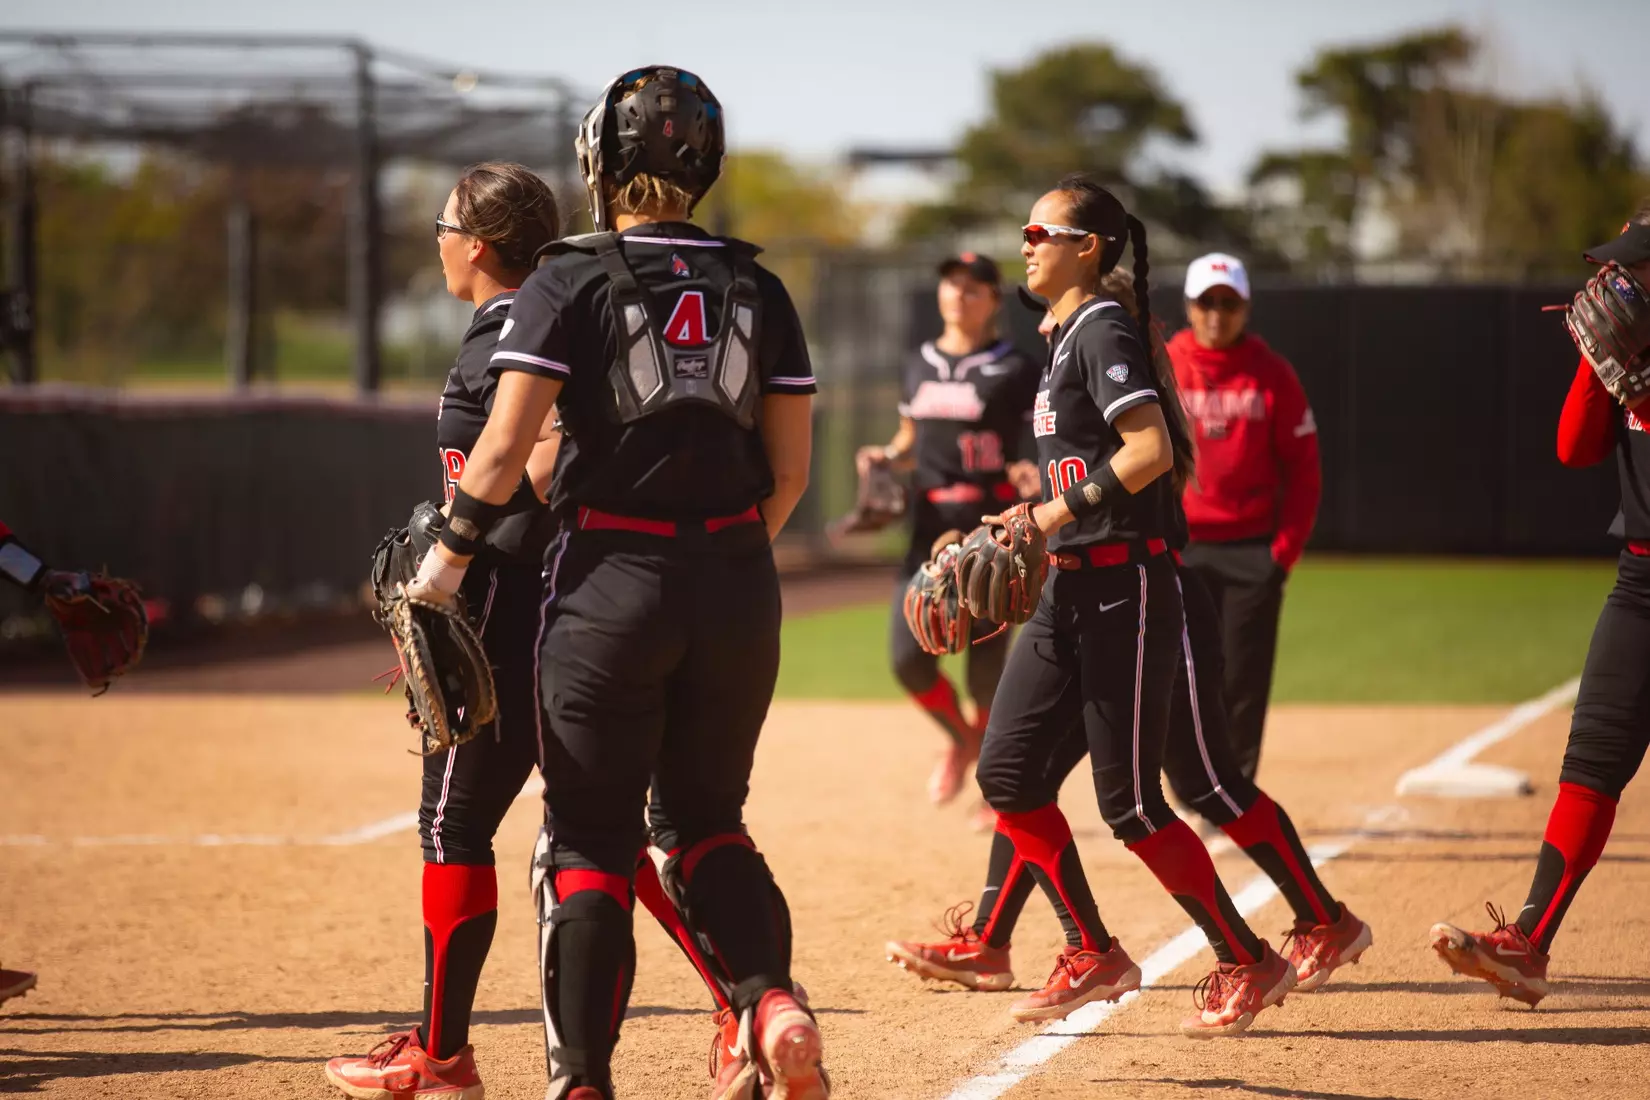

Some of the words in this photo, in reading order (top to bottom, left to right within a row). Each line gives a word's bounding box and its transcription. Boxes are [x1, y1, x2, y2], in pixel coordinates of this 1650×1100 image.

[663, 120, 673, 138] 4
[662, 291, 711, 345] 4
[1048, 456, 1087, 499] 10
